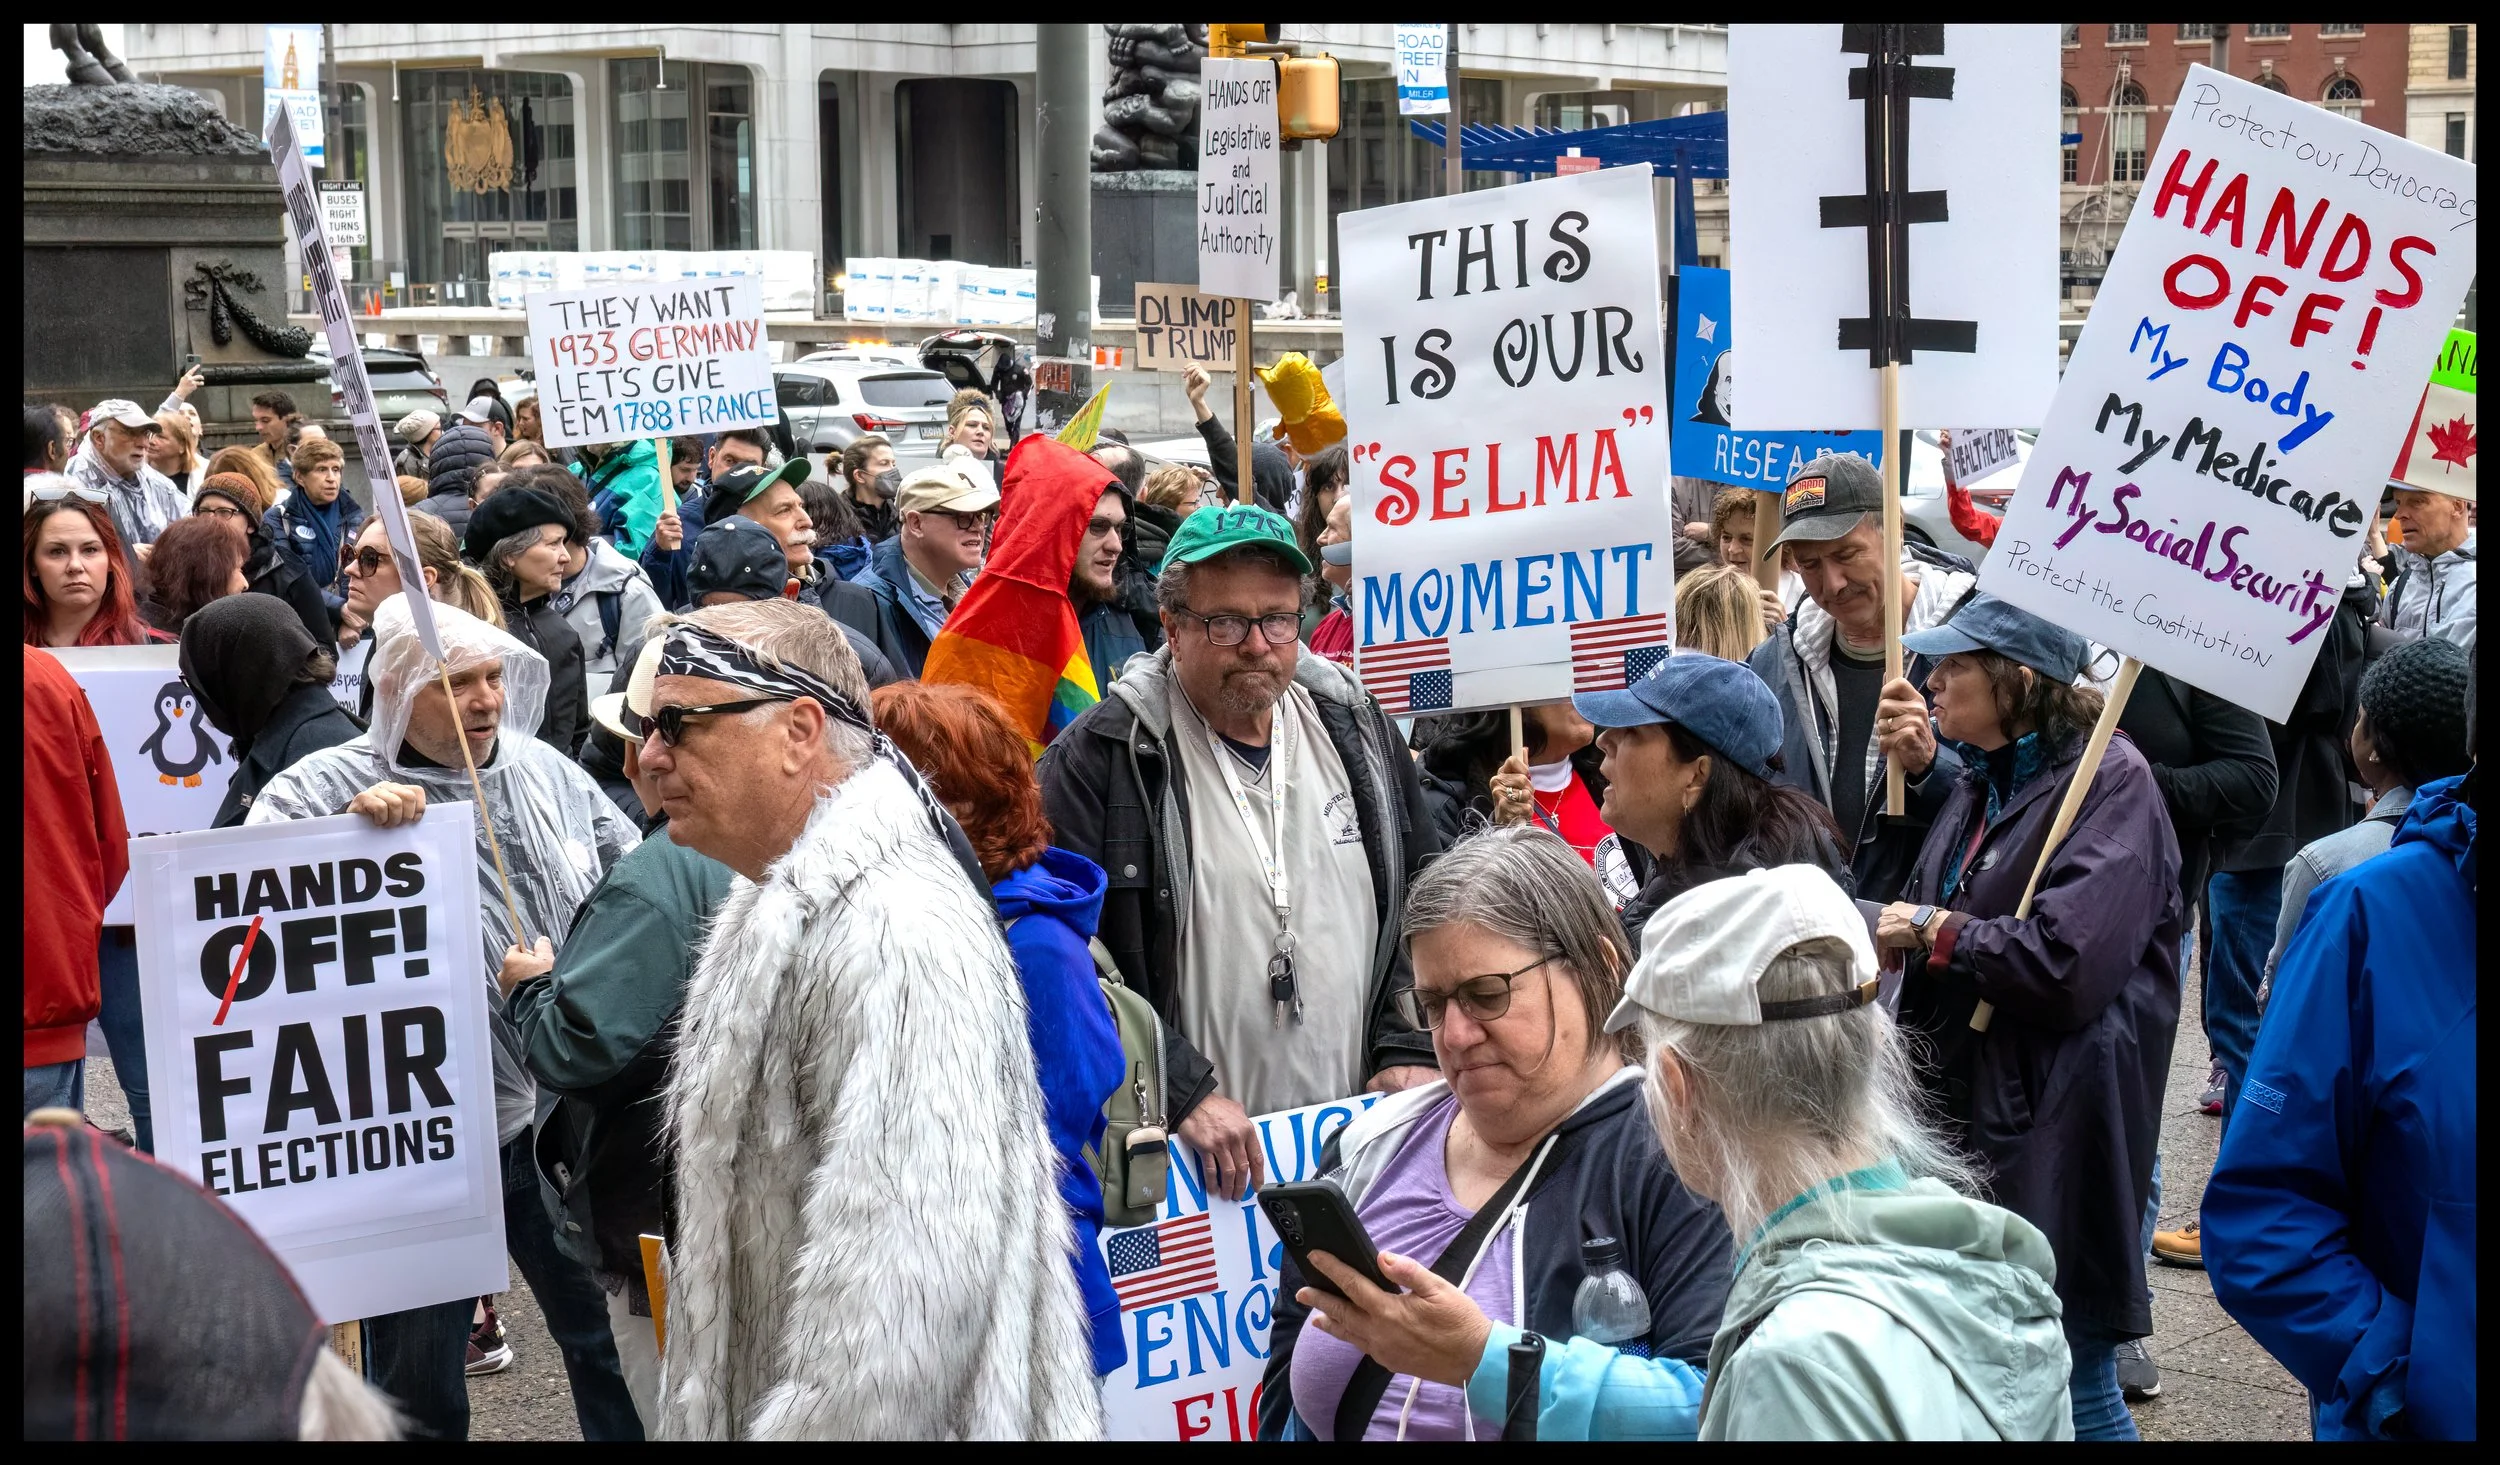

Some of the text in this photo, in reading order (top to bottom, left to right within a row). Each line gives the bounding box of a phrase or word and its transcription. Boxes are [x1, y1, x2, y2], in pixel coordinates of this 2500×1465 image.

[1208, 79, 1271, 110] HANDS OFF
[1409, 89, 1434, 98] MILER
[1205, 123, 1271, 157] Legislative
[2192, 83, 2296, 148] Protect
[2296, 140, 2345, 174] our
[342, 182, 361, 190] LANE
[1232, 156, 1251, 179] and
[327, 195, 358, 205] BUSES
[329, 209, 356, 219] RIGHT
[1202, 183, 1267, 216] Judicial
[329, 222, 360, 231] TURNS
[336, 234, 354, 244] 16th
[357, 234, 366, 244] St
[1199, 222, 1274, 265] Authority
[2153, 149, 2437, 309] HANDS
[1407, 210, 1591, 301] THIS
[548, 295, 641, 331] THEY
[649, 285, 735, 325] WANT
[1140, 295, 1236, 328] DUMP
[2162, 253, 2383, 371] OFF!
[549, 318, 760, 368] 1933 GERMANY
[1138, 326, 1237, 362] TRUMP
[1380, 305, 1644, 406] IS OUR
[555, 359, 725, 404] LET'S GIVE
[2129, 315, 2189, 382] My
[2207, 341, 2335, 455] Body
[613, 400, 674, 434] 1788
[678, 388, 776, 426] FRANCE
[1951, 428, 2017, 480] HEALTHCARE
[2095, 392, 2364, 539] My Medicare
[1213, 511, 1285, 542] 1776
[1362, 542, 1653, 646] MOMENT
[2006, 540, 2086, 595] Protect
[2094, 579, 2125, 613] the
[2132, 592, 2274, 669] Constitution
[2204, 525, 2340, 646] Security
[1323, 791, 1347, 818] MED-TEX
[193, 851, 426, 922] HANDS
[199, 904, 430, 1003] OFF!
[193, 1005, 457, 1144] FAIR
[200, 1115, 456, 1197] ELECTIONS
